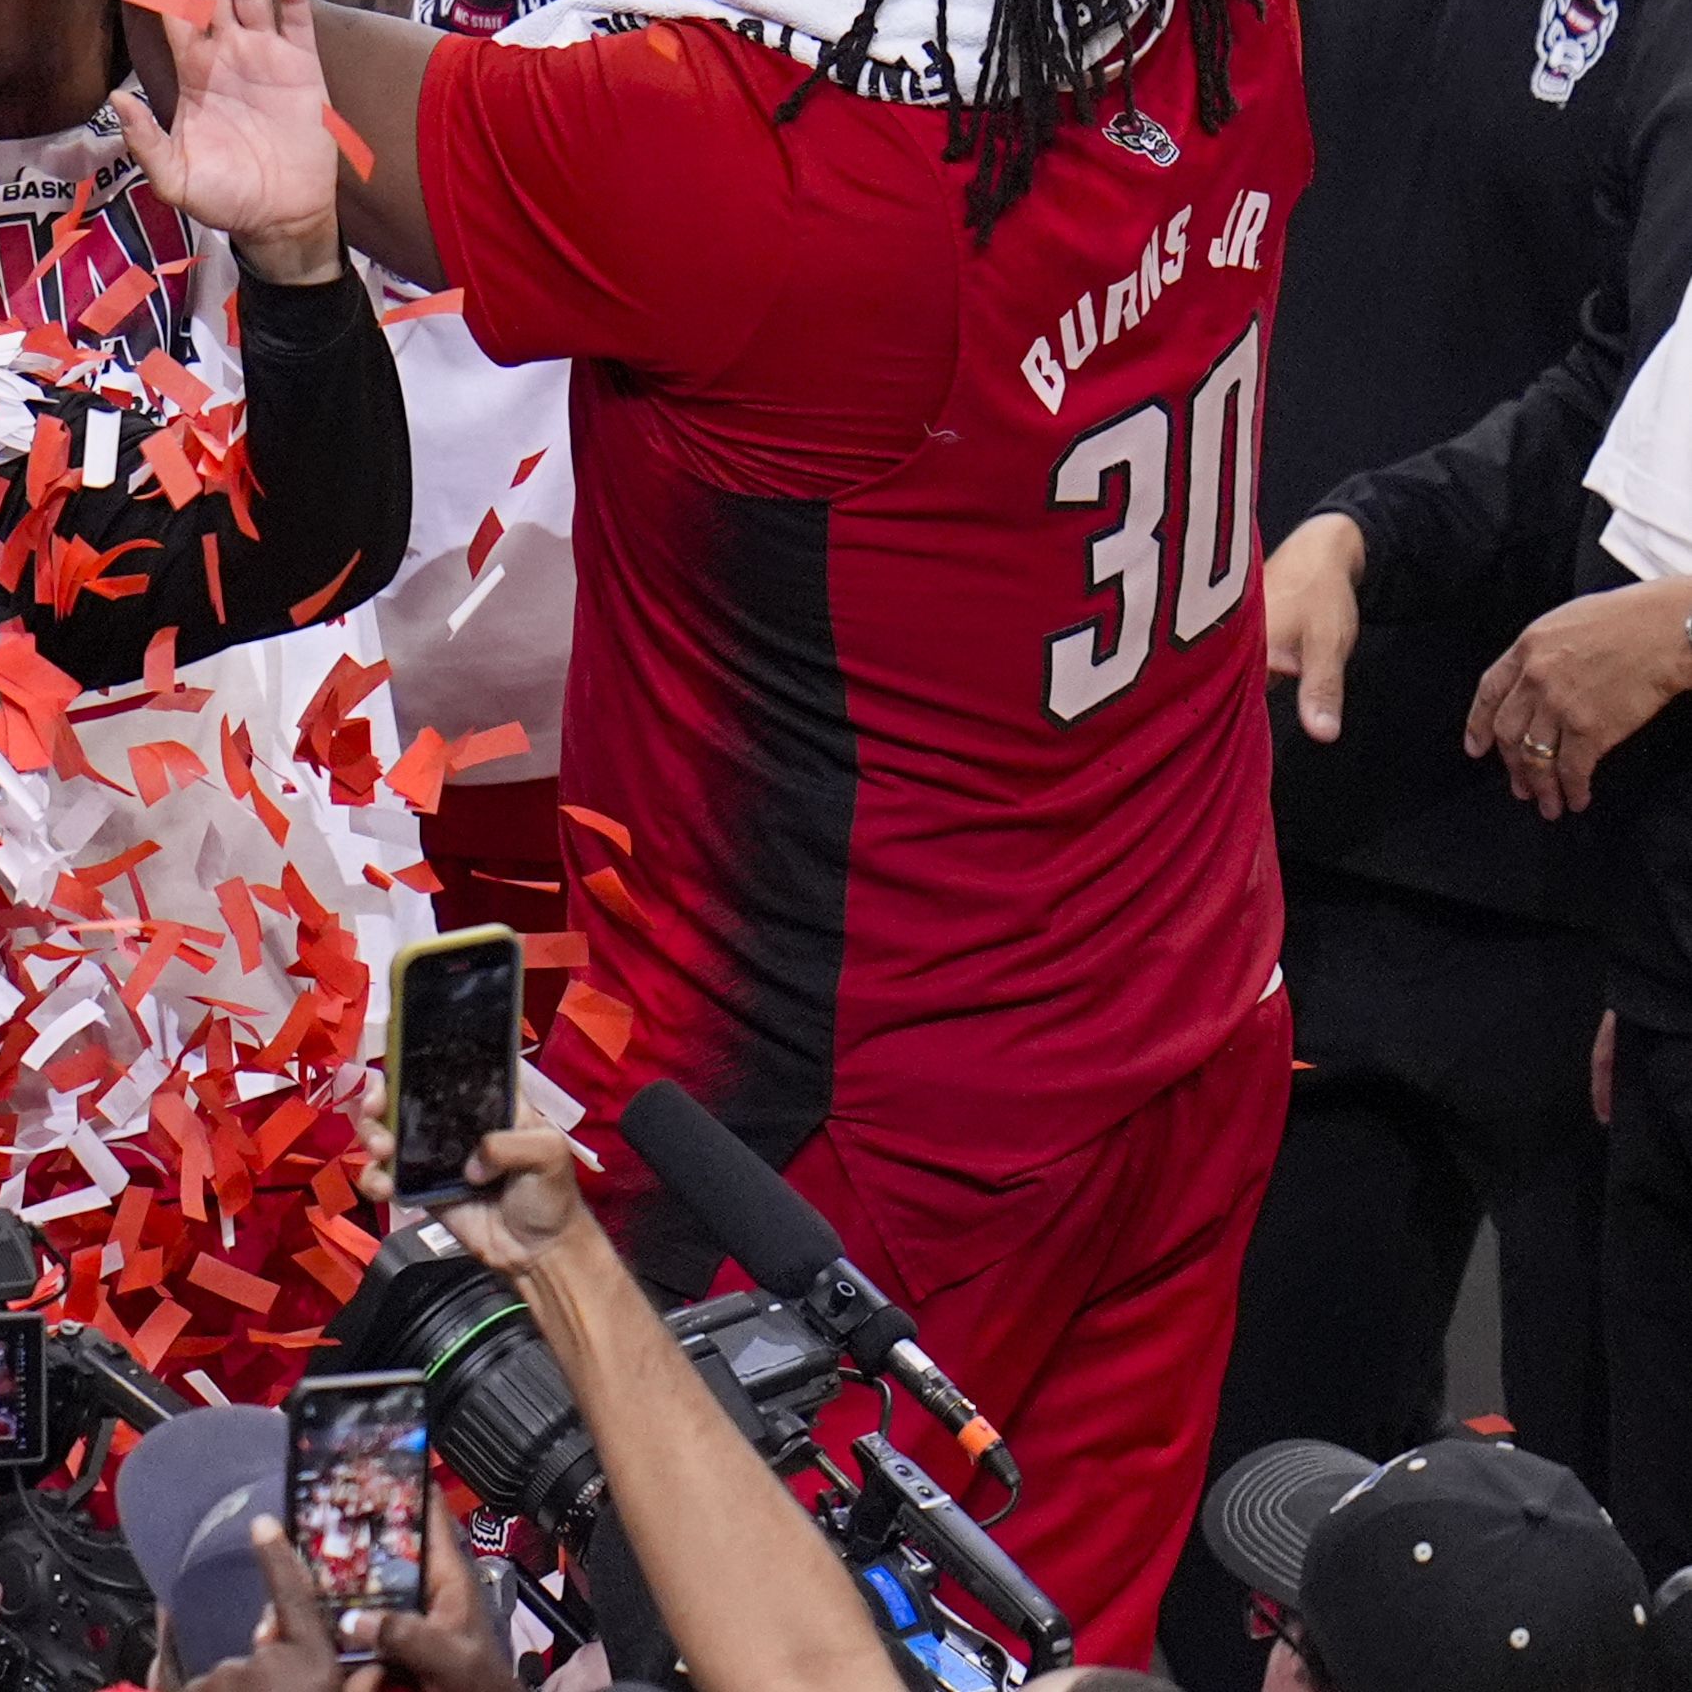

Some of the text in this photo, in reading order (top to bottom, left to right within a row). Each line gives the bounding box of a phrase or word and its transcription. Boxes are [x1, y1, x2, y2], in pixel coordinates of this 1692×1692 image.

[471, 13, 504, 30] STATE
[1021, 189, 1271, 416] BURNS JR
[1048, 316, 1261, 724] 30
